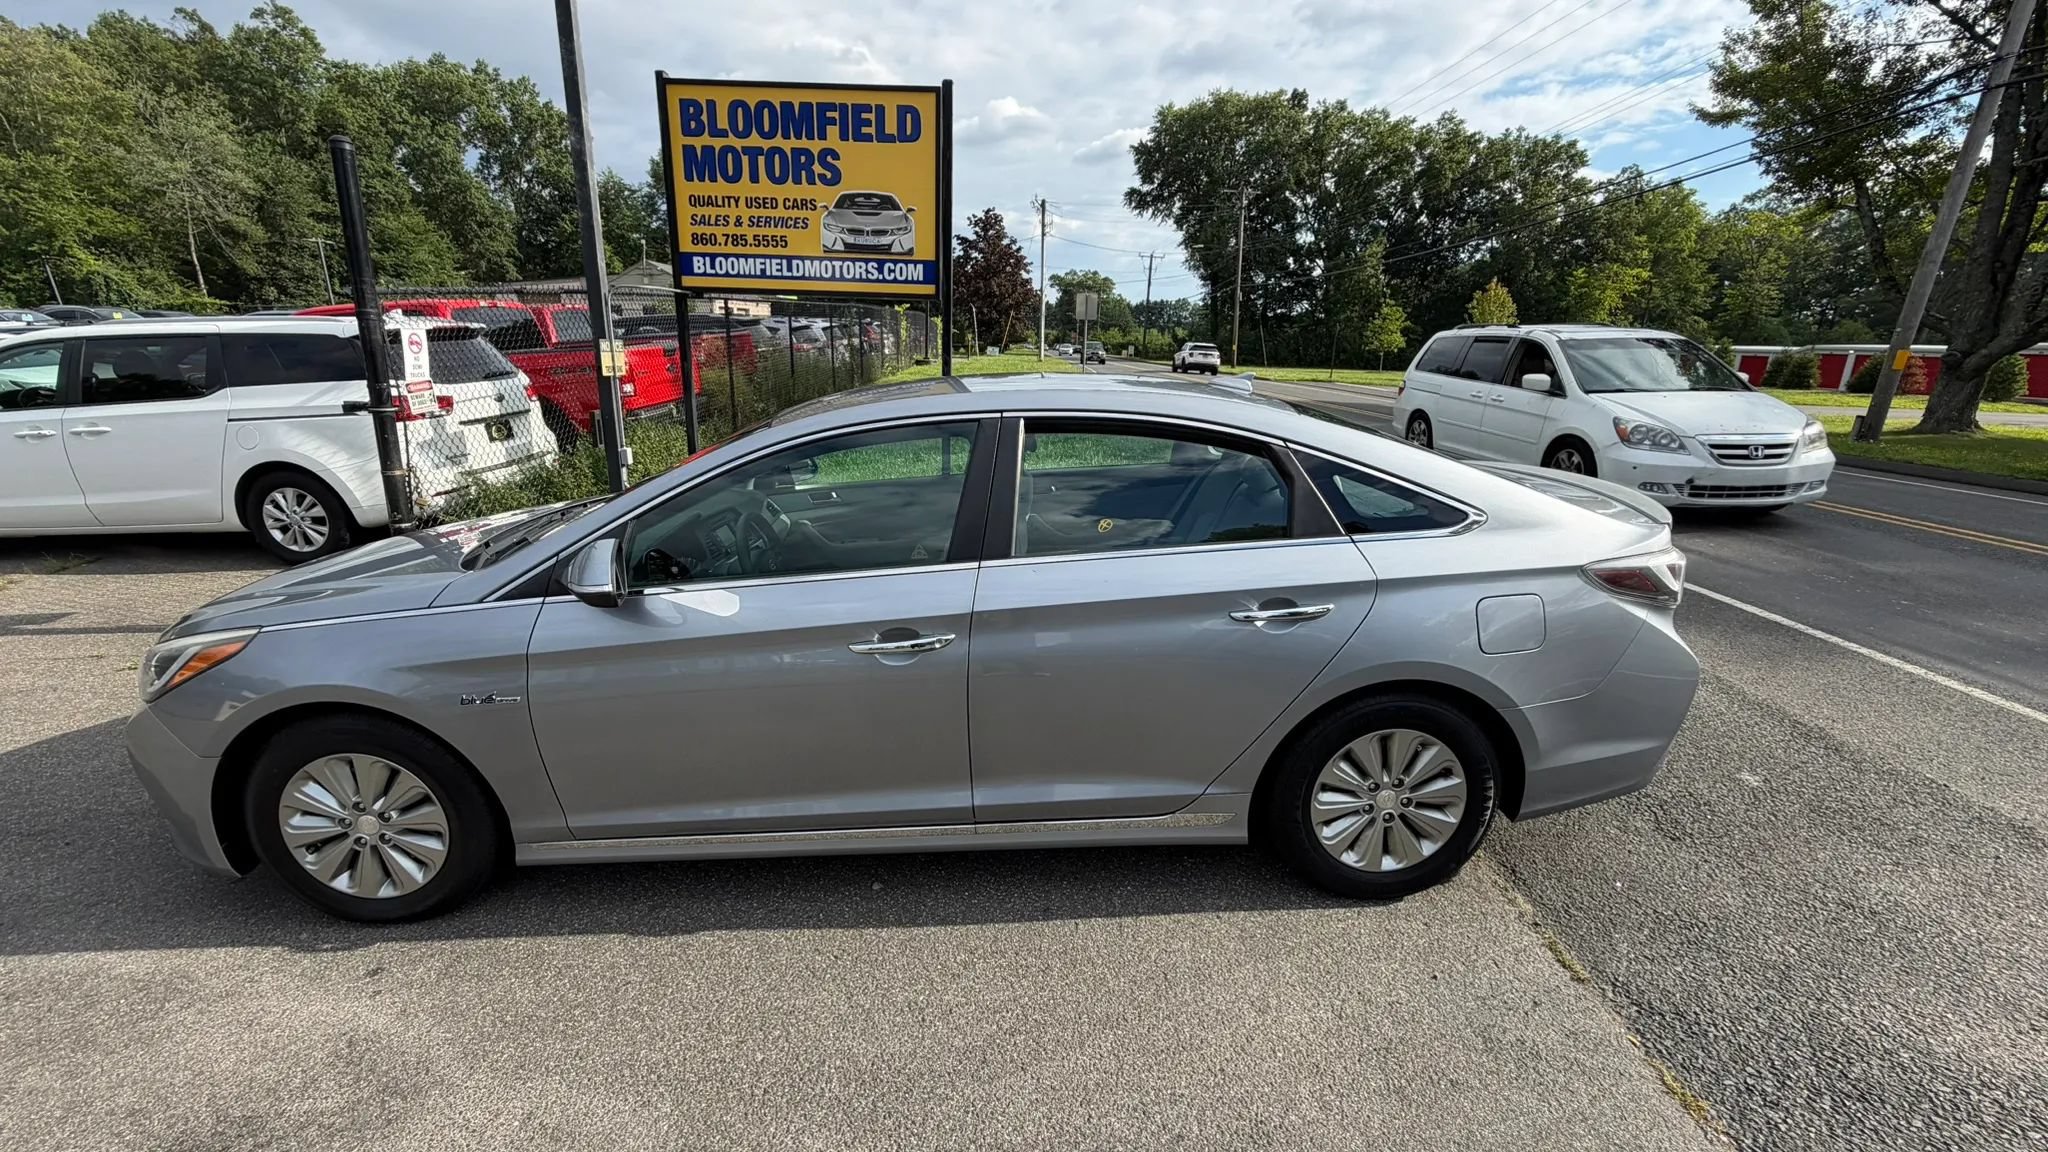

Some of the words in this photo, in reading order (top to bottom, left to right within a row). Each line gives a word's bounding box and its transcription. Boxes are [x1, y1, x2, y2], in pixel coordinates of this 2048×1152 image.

[678, 98, 922, 143] BLOOMFIELD
[681, 144, 842, 187] MOTORS
[688, 194, 741, 209] QUALITY
[745, 196, 778, 210] USED
[783, 197, 817, 212] CARS
[690, 213, 730, 228] SALES
[733, 214, 744, 228] &
[747, 215, 810, 230] SERVICES
[691, 232, 788, 249] 860.785.5555
[692, 256, 924, 281] BLOOMFIELDMOTORS.COM
[601, 340, 624, 352] NOCE
